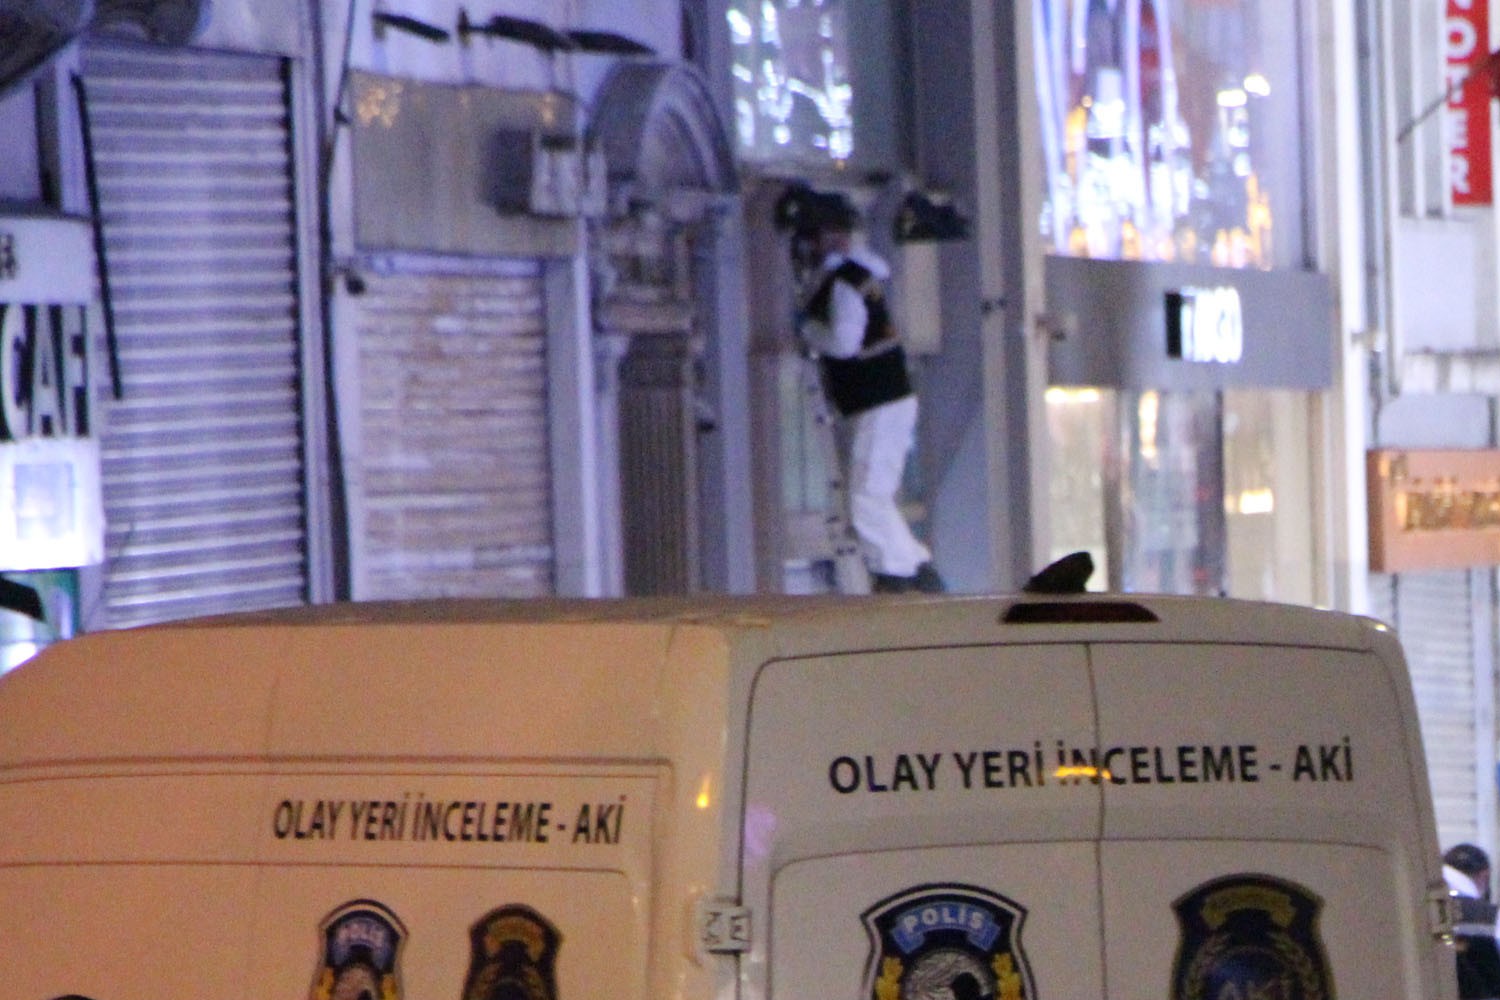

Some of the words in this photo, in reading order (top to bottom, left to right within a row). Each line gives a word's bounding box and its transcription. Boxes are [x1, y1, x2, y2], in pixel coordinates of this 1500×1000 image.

[828, 754, 942, 793] OLAY
[953, 741, 1045, 788] YERİ
[1055, 740, 1259, 787] İNCELEME
[1293, 736, 1354, 782] AKİ
[273, 799, 345, 841] OLAY
[350, 791, 409, 841] YERİ
[412, 791, 553, 843] İNCELEME
[572, 794, 627, 844] AKİ
[903, 905, 986, 933] POLİS
